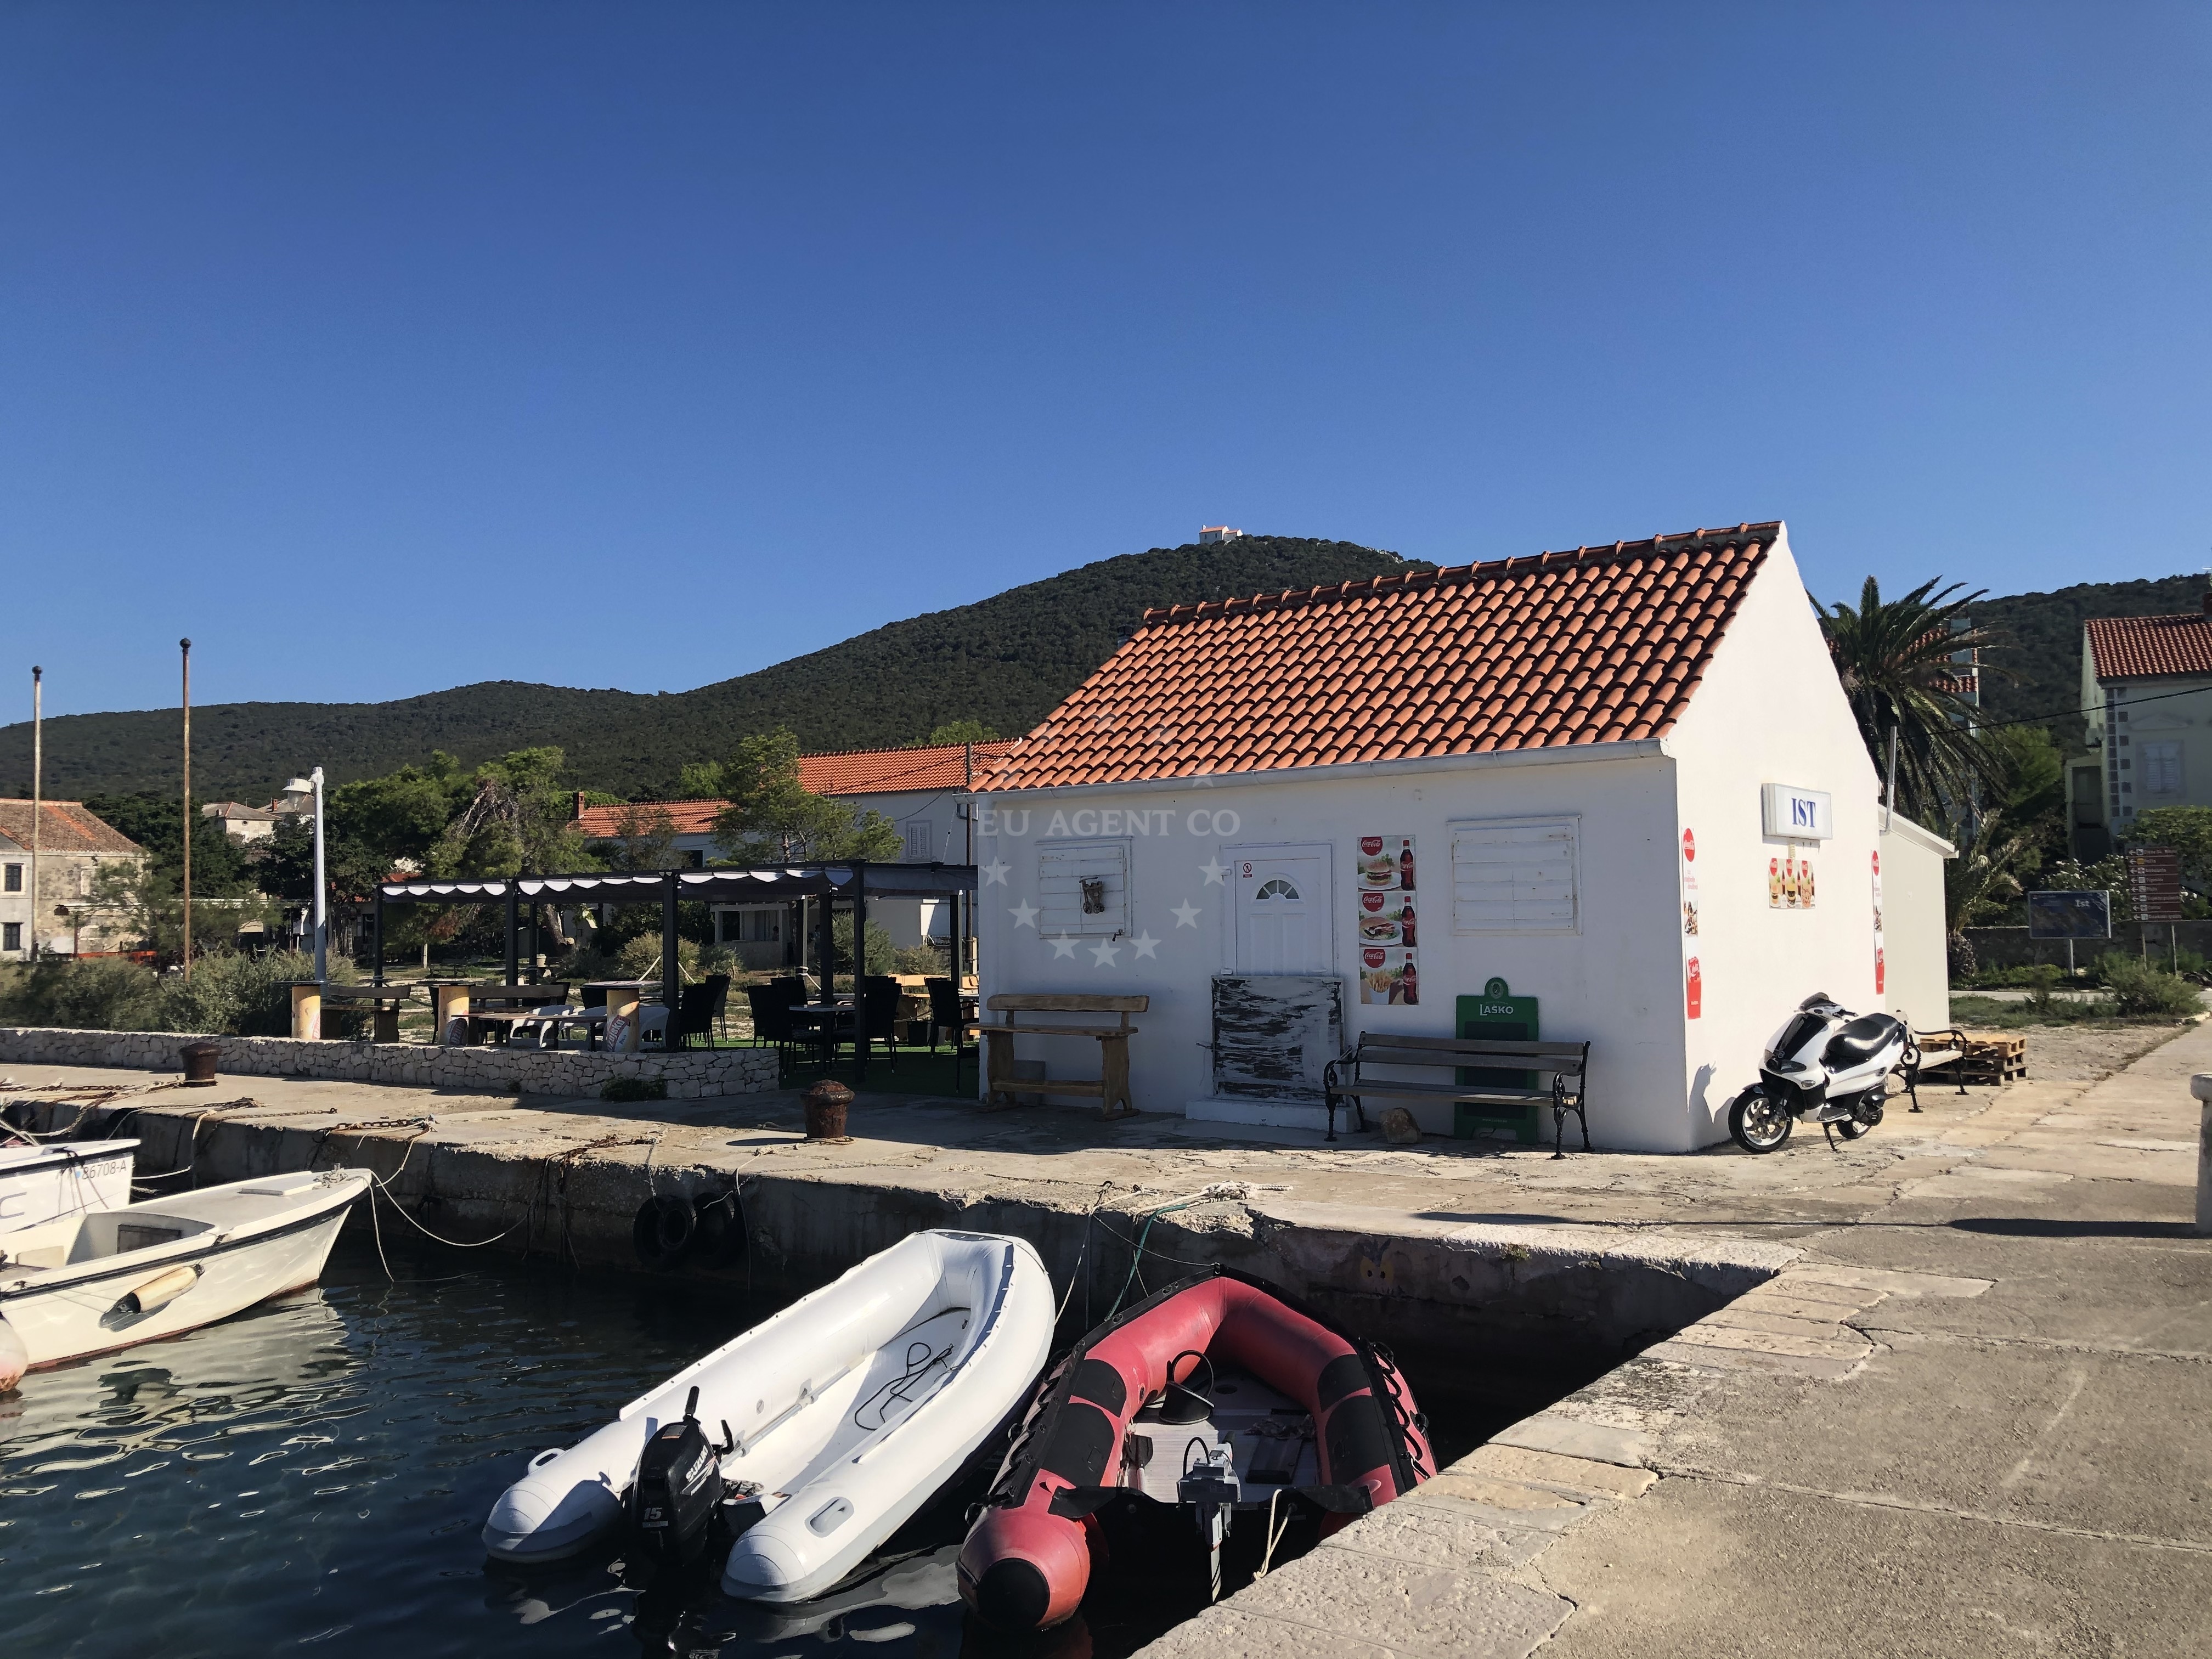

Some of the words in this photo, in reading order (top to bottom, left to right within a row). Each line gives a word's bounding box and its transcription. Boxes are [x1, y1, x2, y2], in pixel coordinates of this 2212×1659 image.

[1791, 798, 1815, 828] IST
[82, 1160, 127, 1180] 86708-A
[686, 1444, 708, 1482] SUZUKI
[644, 1507, 662, 1520] 15
